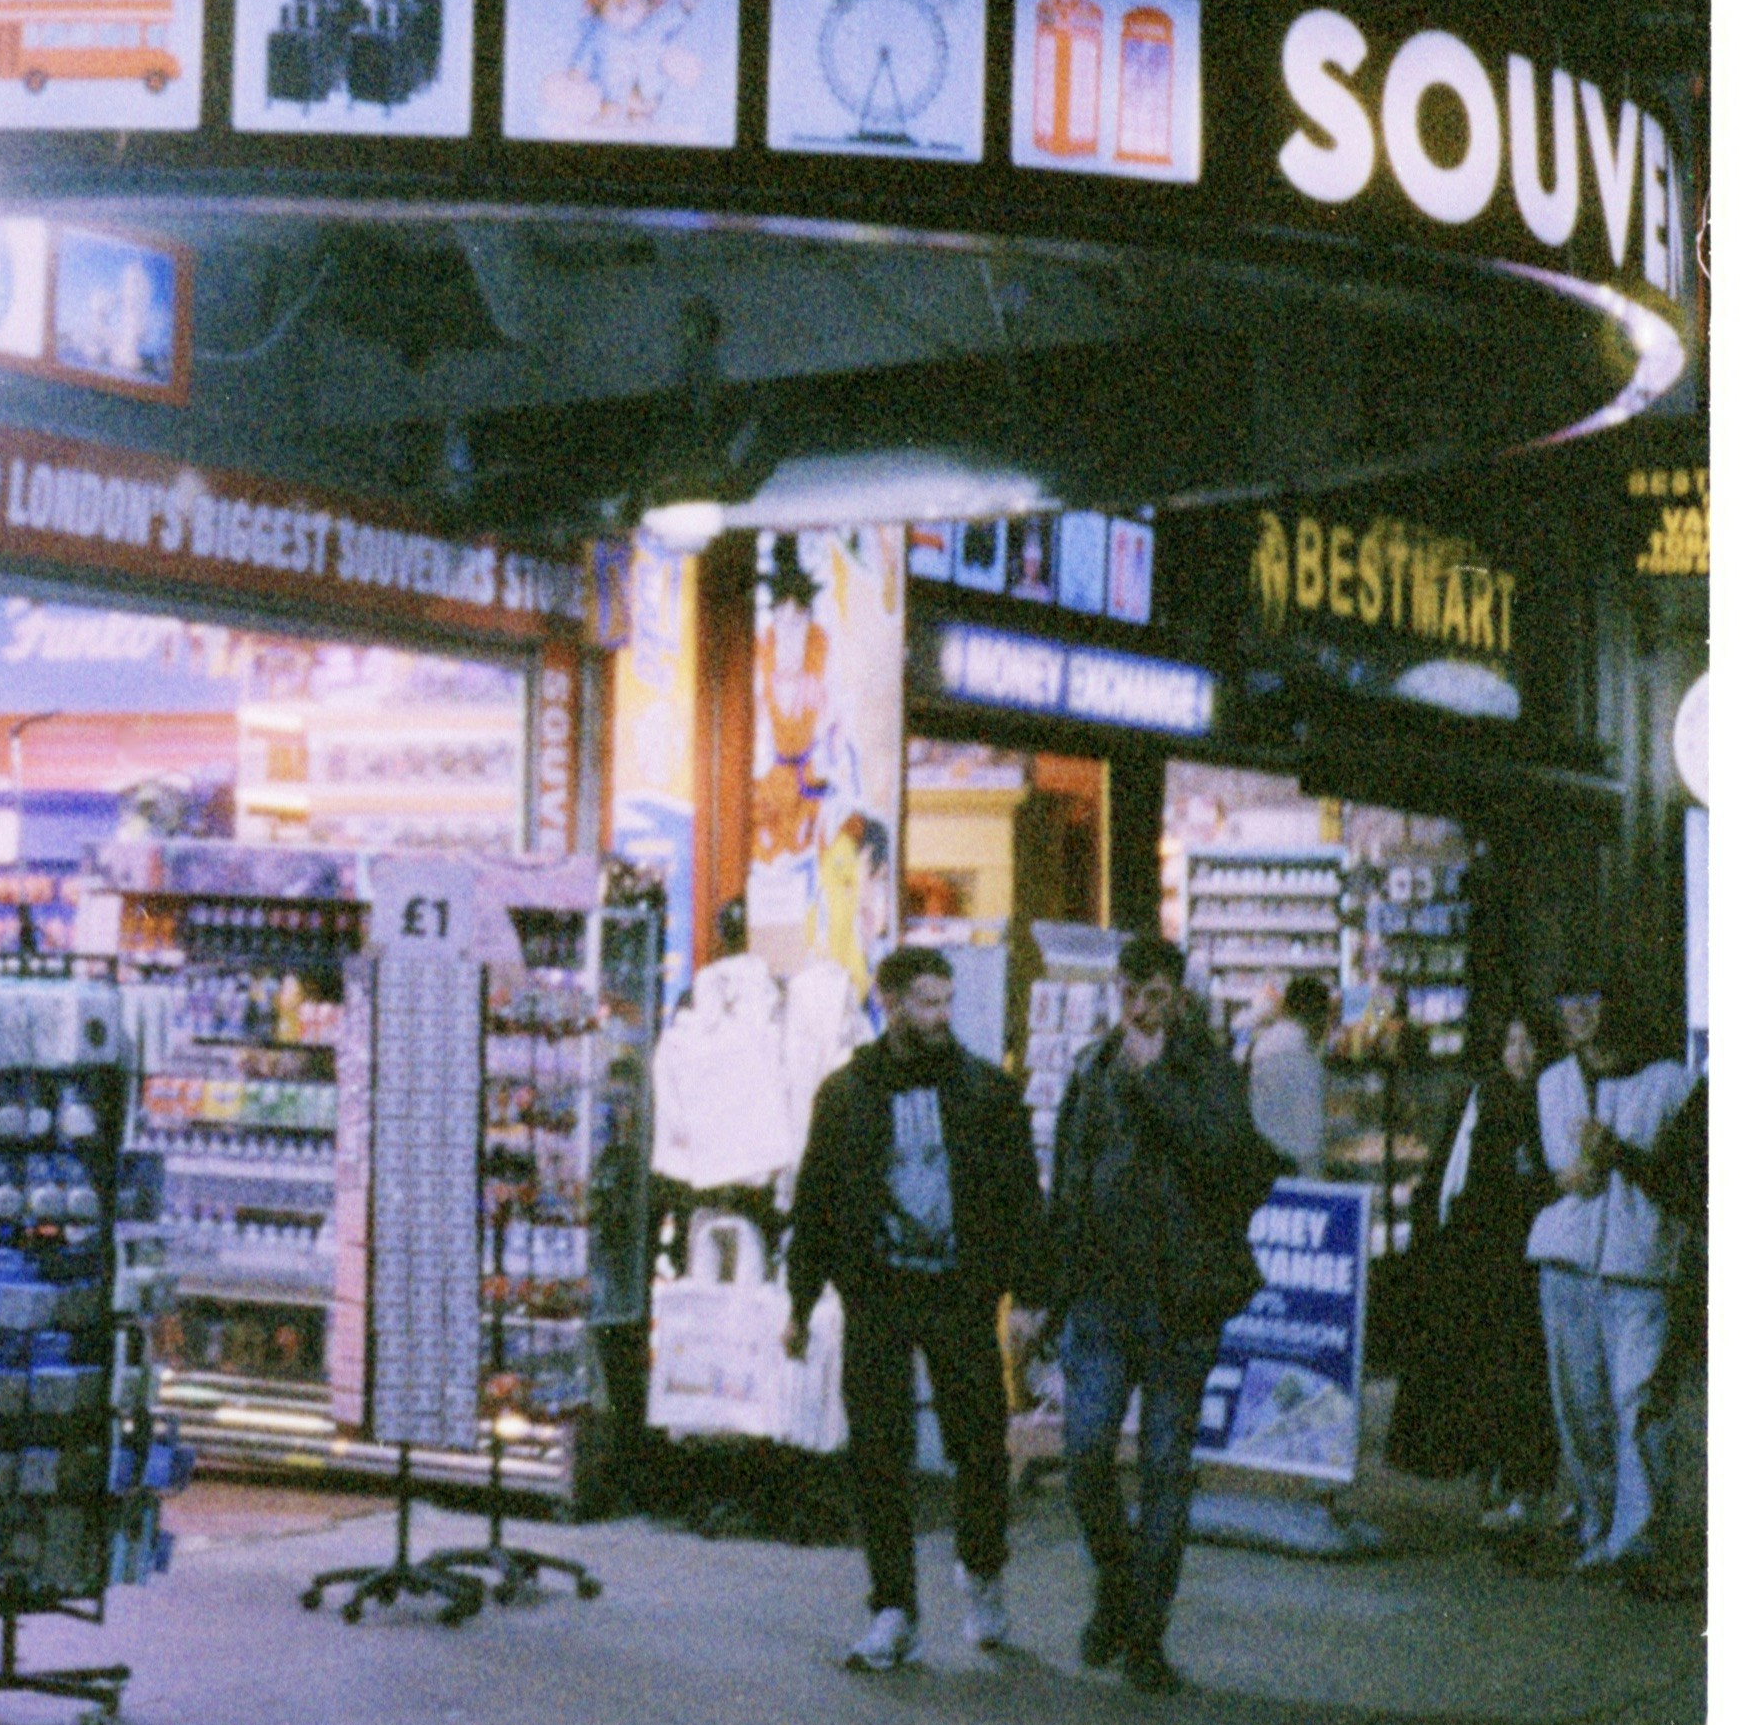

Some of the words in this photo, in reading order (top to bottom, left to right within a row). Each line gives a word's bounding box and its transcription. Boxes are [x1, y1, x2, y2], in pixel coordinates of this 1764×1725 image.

[8, 458, 185, 555] LONDON'S
[190, 493, 328, 576] BIGGEST
[1662, 505, 1709, 534] VA
[400, 894, 450, 939] £1
[1245, 1204, 1329, 1248] ONEY
